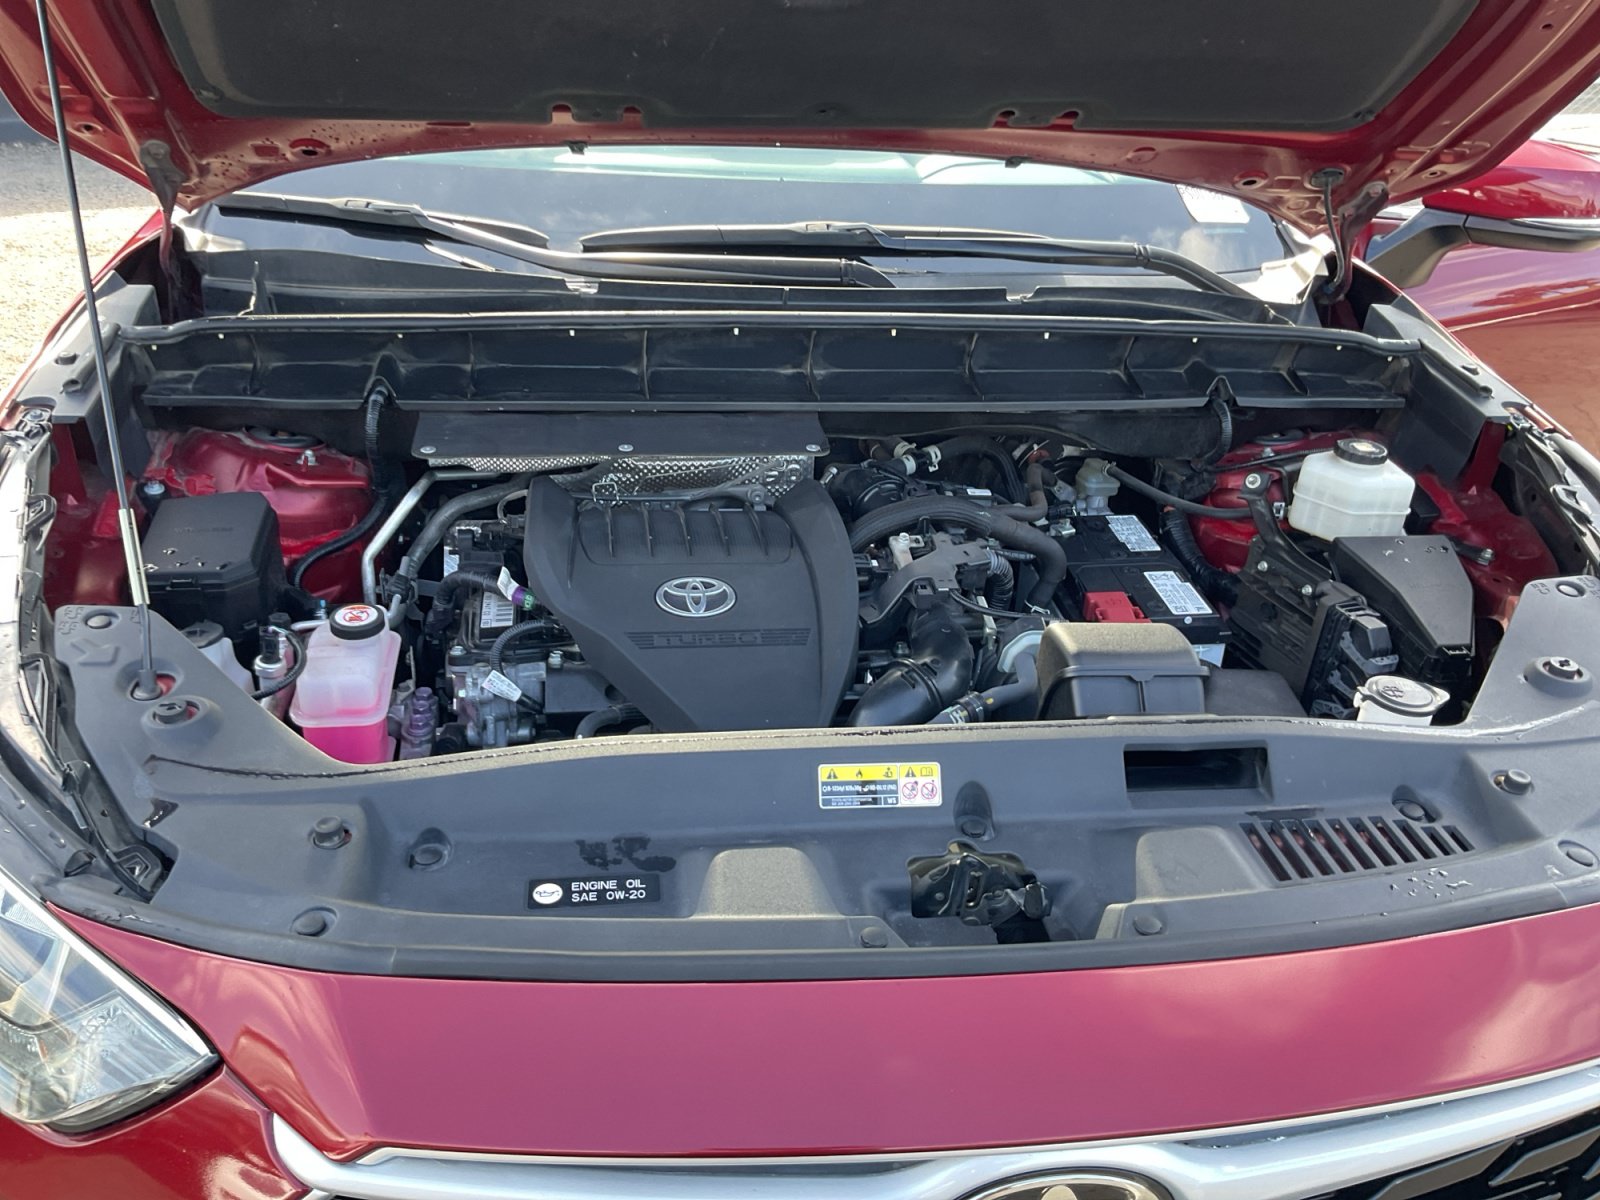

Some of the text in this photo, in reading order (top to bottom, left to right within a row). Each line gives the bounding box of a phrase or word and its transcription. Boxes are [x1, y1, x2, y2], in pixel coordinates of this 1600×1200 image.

[656, 633, 759, 646] TURBO
[571, 879, 646, 891] ENGINE OIL
[571, 889, 646, 902] SAE 0W-20
